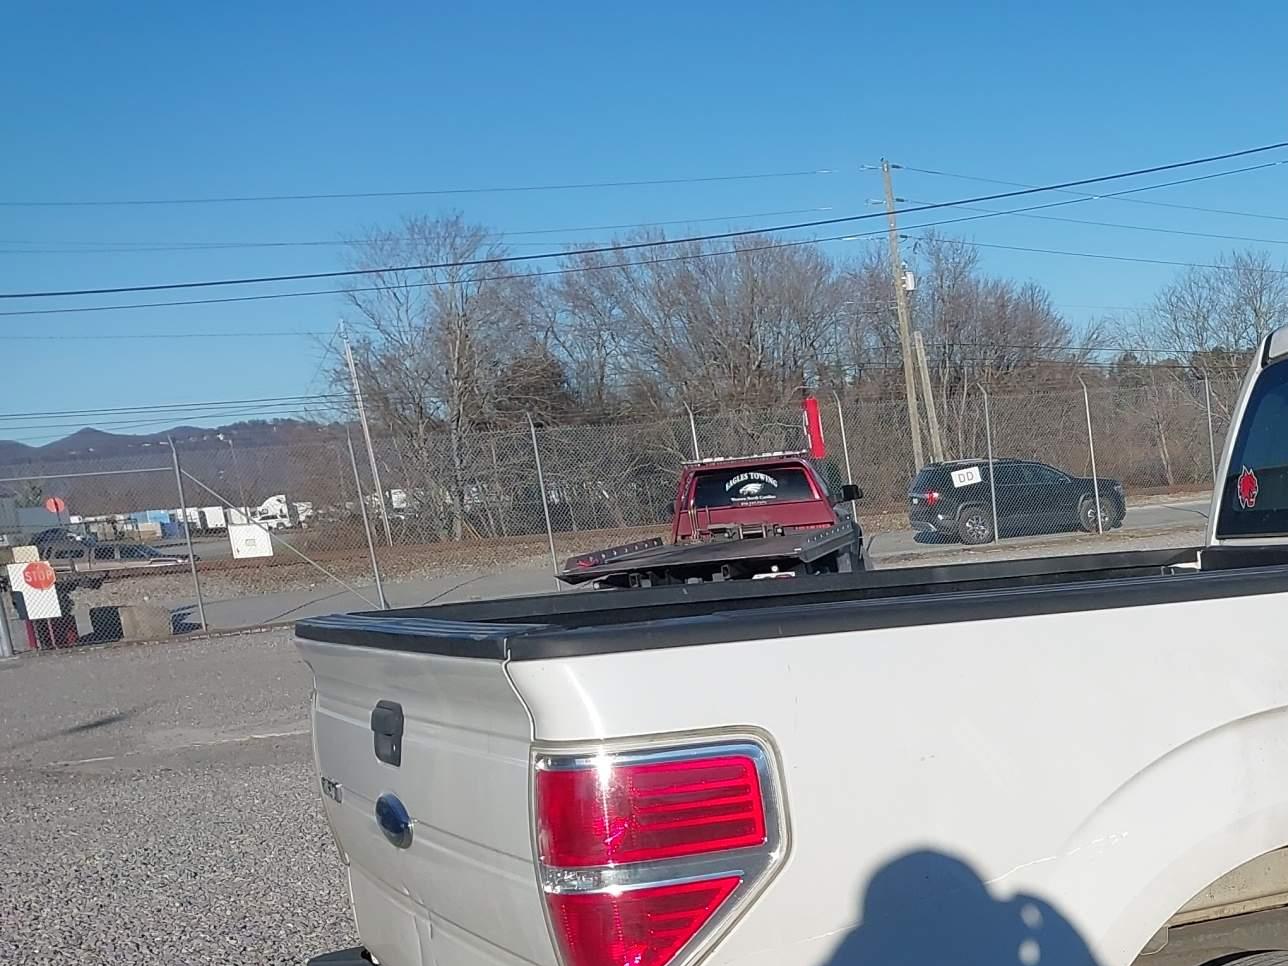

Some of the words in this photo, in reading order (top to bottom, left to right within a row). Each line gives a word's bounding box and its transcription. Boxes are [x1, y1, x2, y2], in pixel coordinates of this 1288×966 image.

[725, 472, 748, 492] EAGLES
[748, 472, 778, 488] TOWING
[24, 571, 53, 582] STOP
